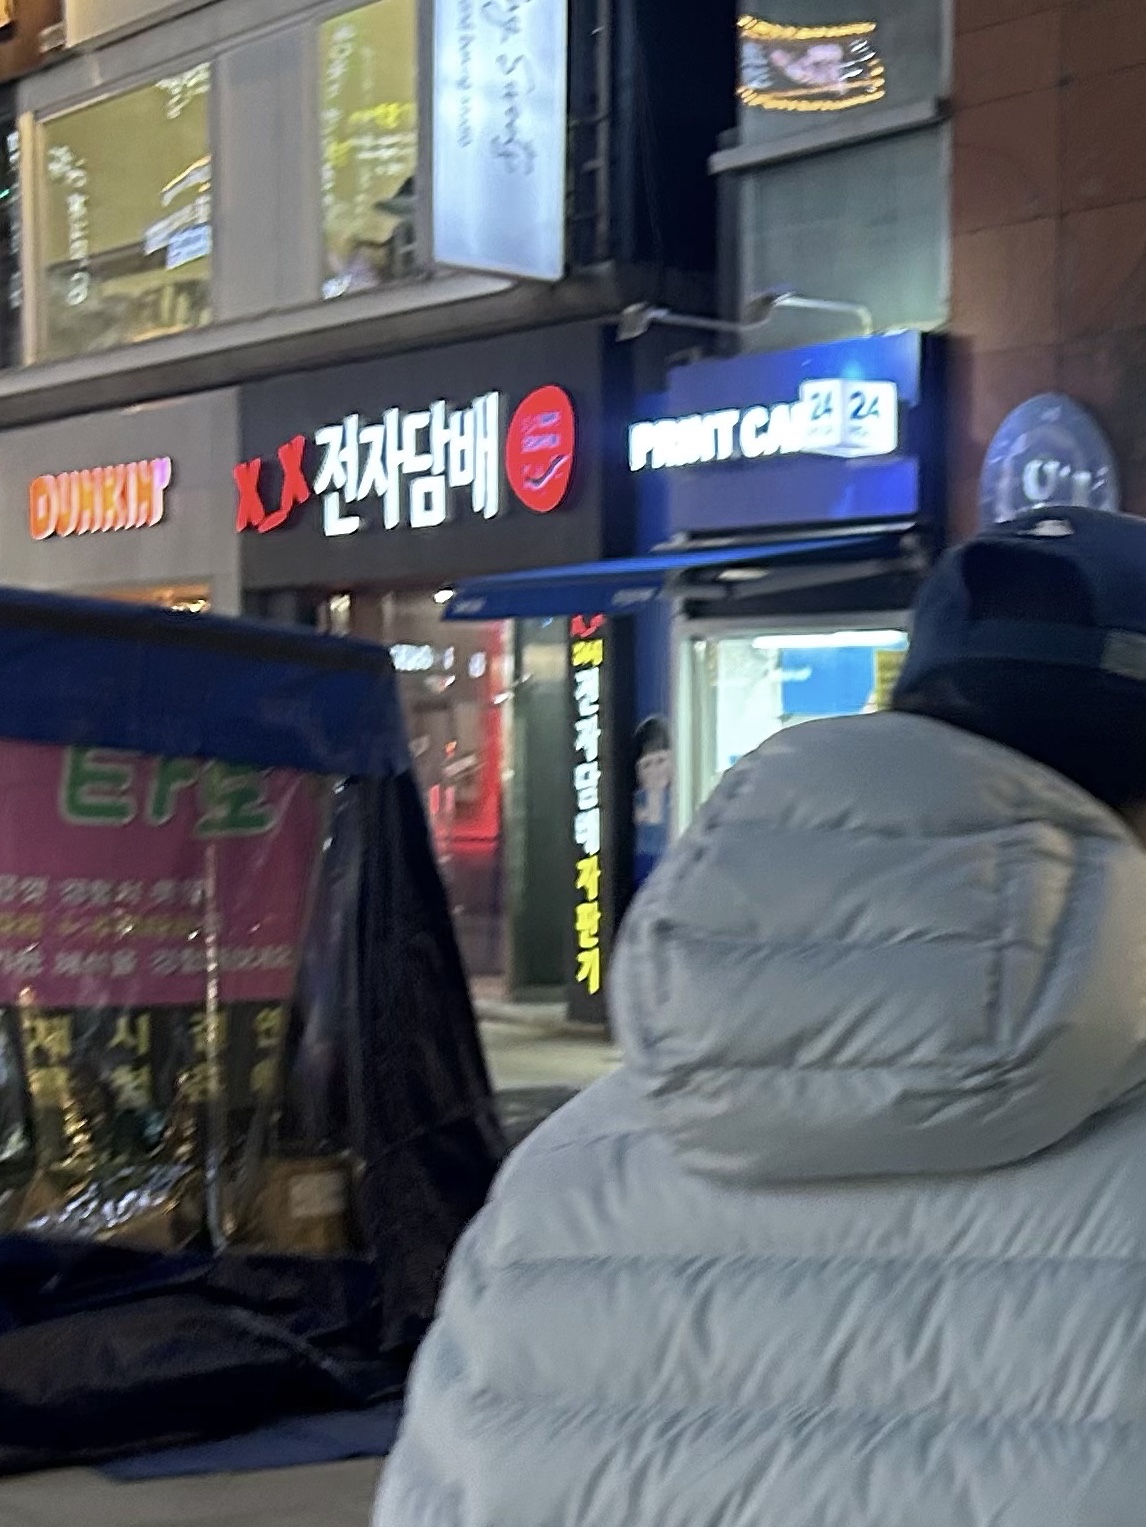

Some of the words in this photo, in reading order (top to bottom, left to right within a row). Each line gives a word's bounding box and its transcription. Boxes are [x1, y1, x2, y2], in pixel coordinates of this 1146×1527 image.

[314, 390, 500, 538] 전자담배
[849, 389, 880, 421] 24
[574, 854, 601, 995] 자판기
